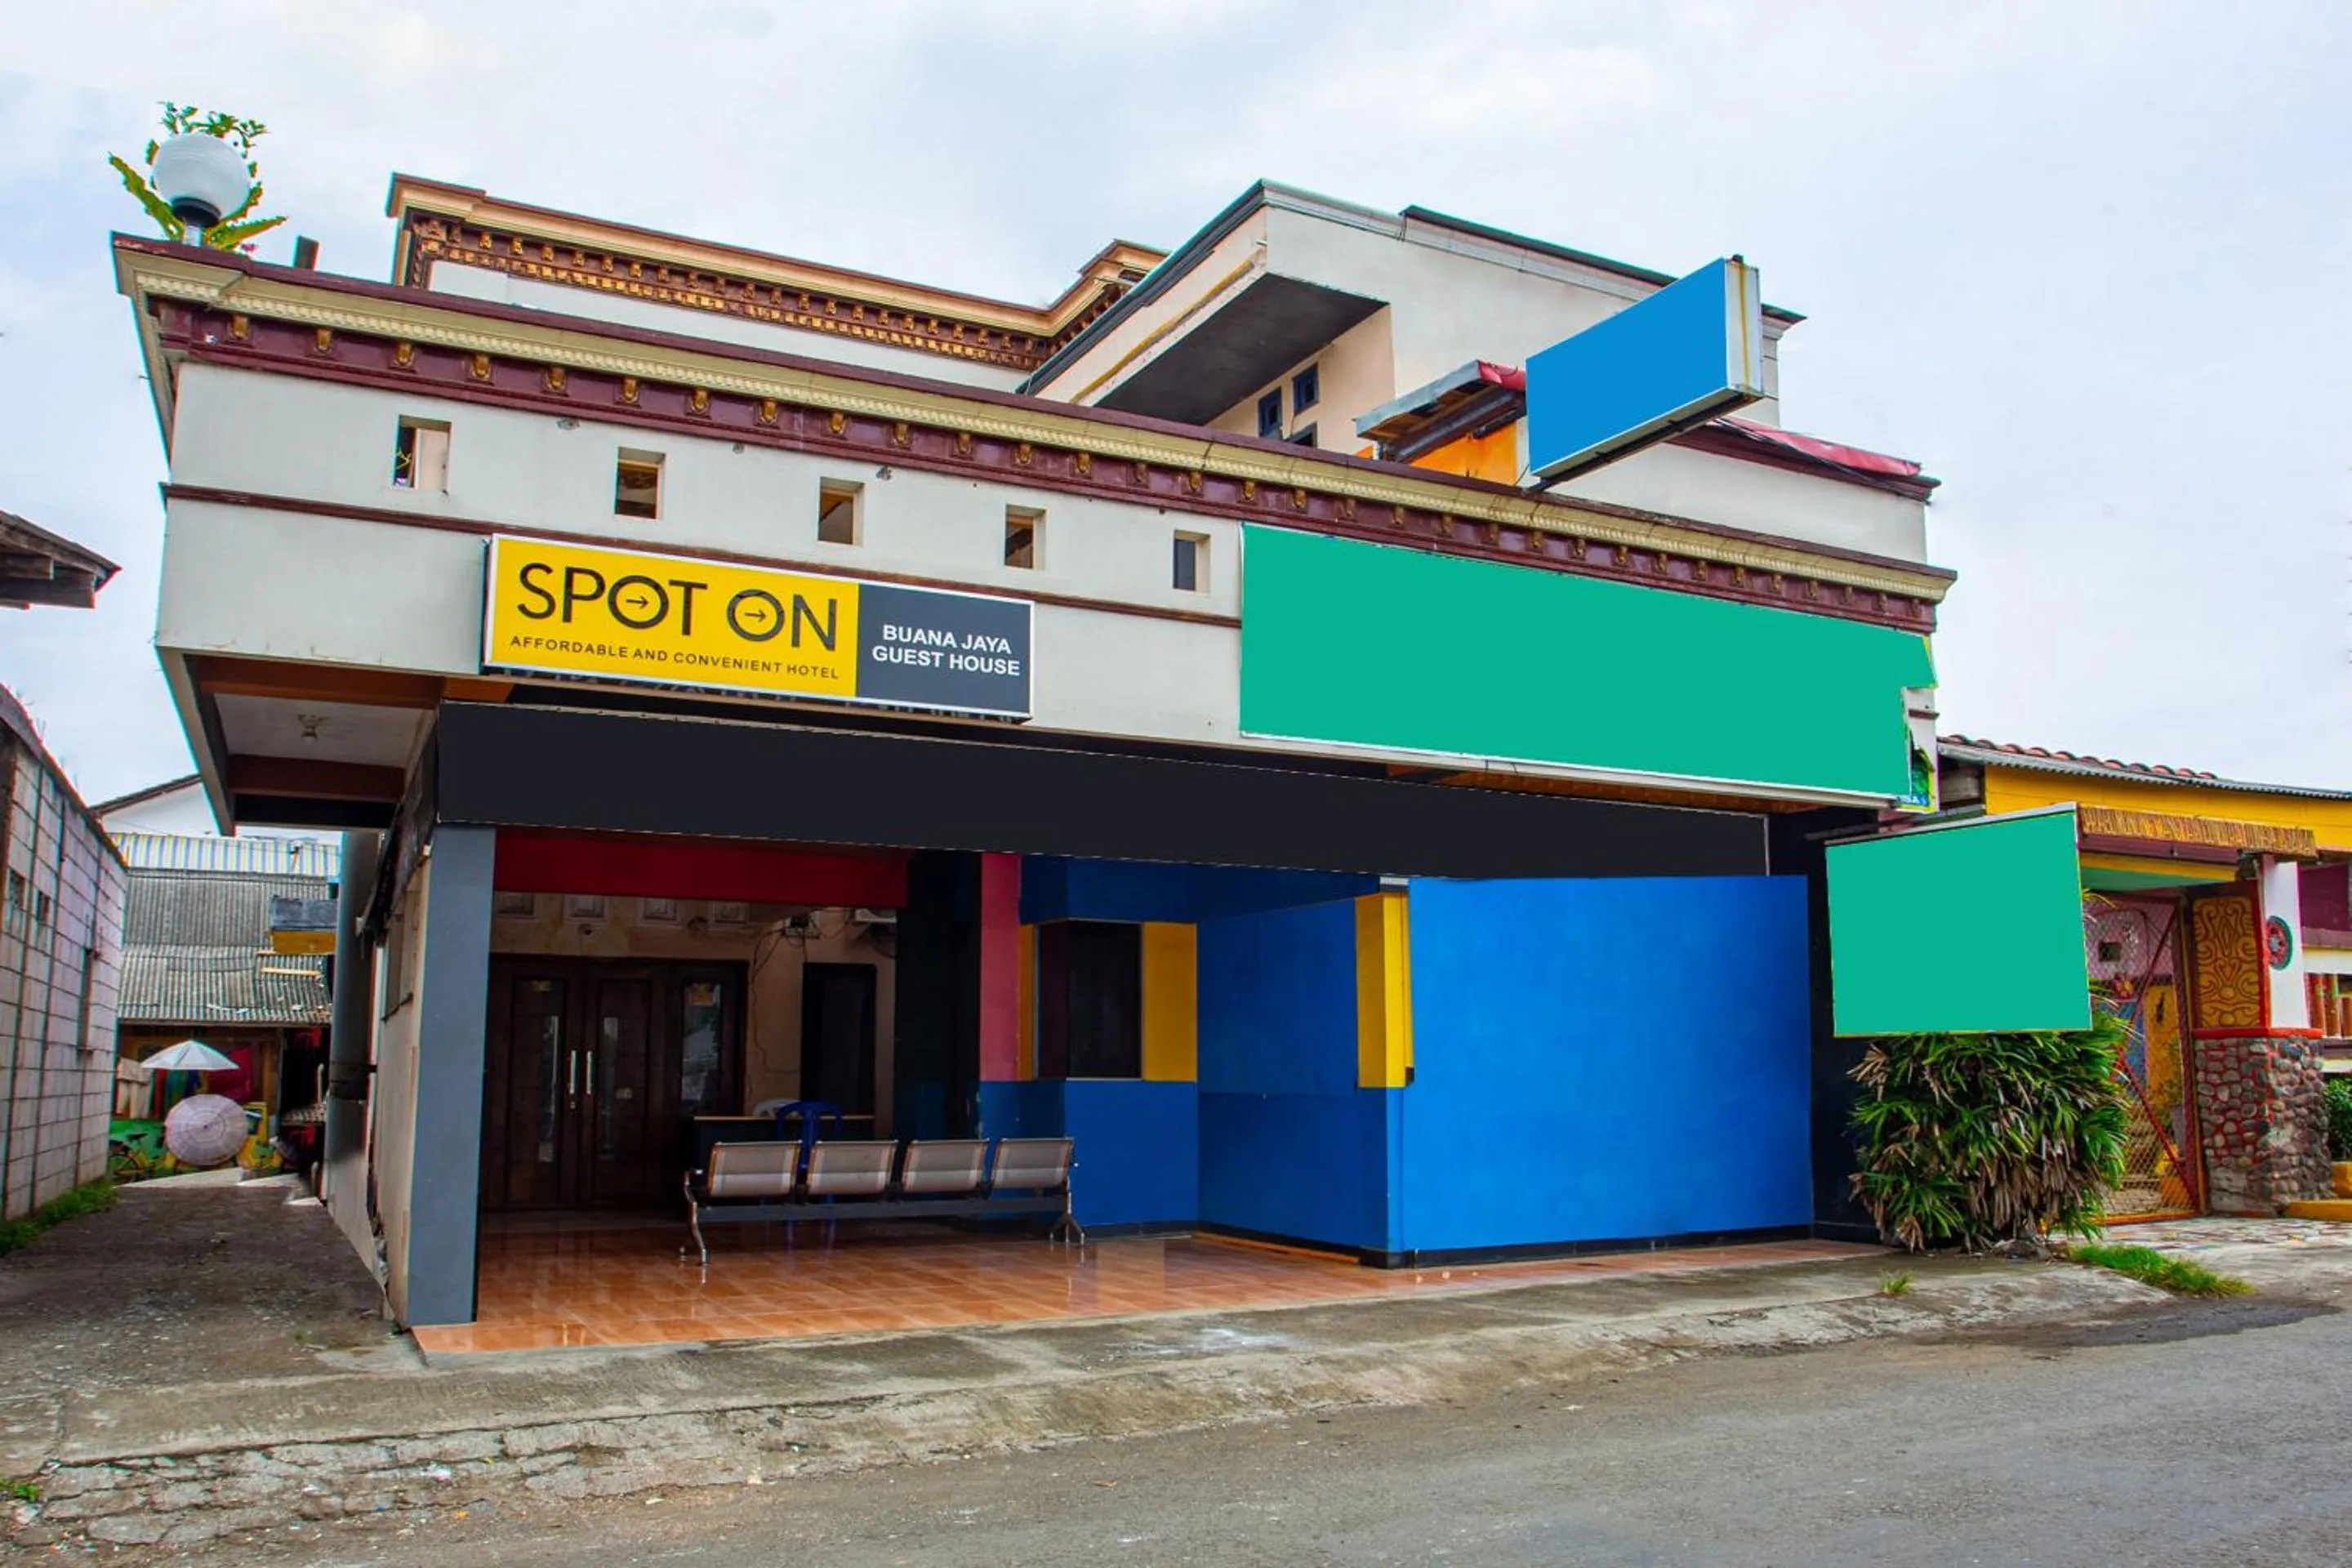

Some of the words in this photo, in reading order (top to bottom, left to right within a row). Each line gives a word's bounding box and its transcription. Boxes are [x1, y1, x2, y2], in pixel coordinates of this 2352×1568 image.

[517, 563, 708, 636] SPOT
[727, 589, 837, 652] ON
[510, 635, 628, 657] AFFORDABLE
[634, 648, 667, 662] AND
[674, 653, 781, 673] CONVENIENT
[786, 665, 839, 679] HOTEL
[883, 624, 957, 648] BUANA
[960, 634, 1011, 654] JAYA
[872, 645, 943, 667] GUEST
[949, 655, 1020, 676] HOUSE
